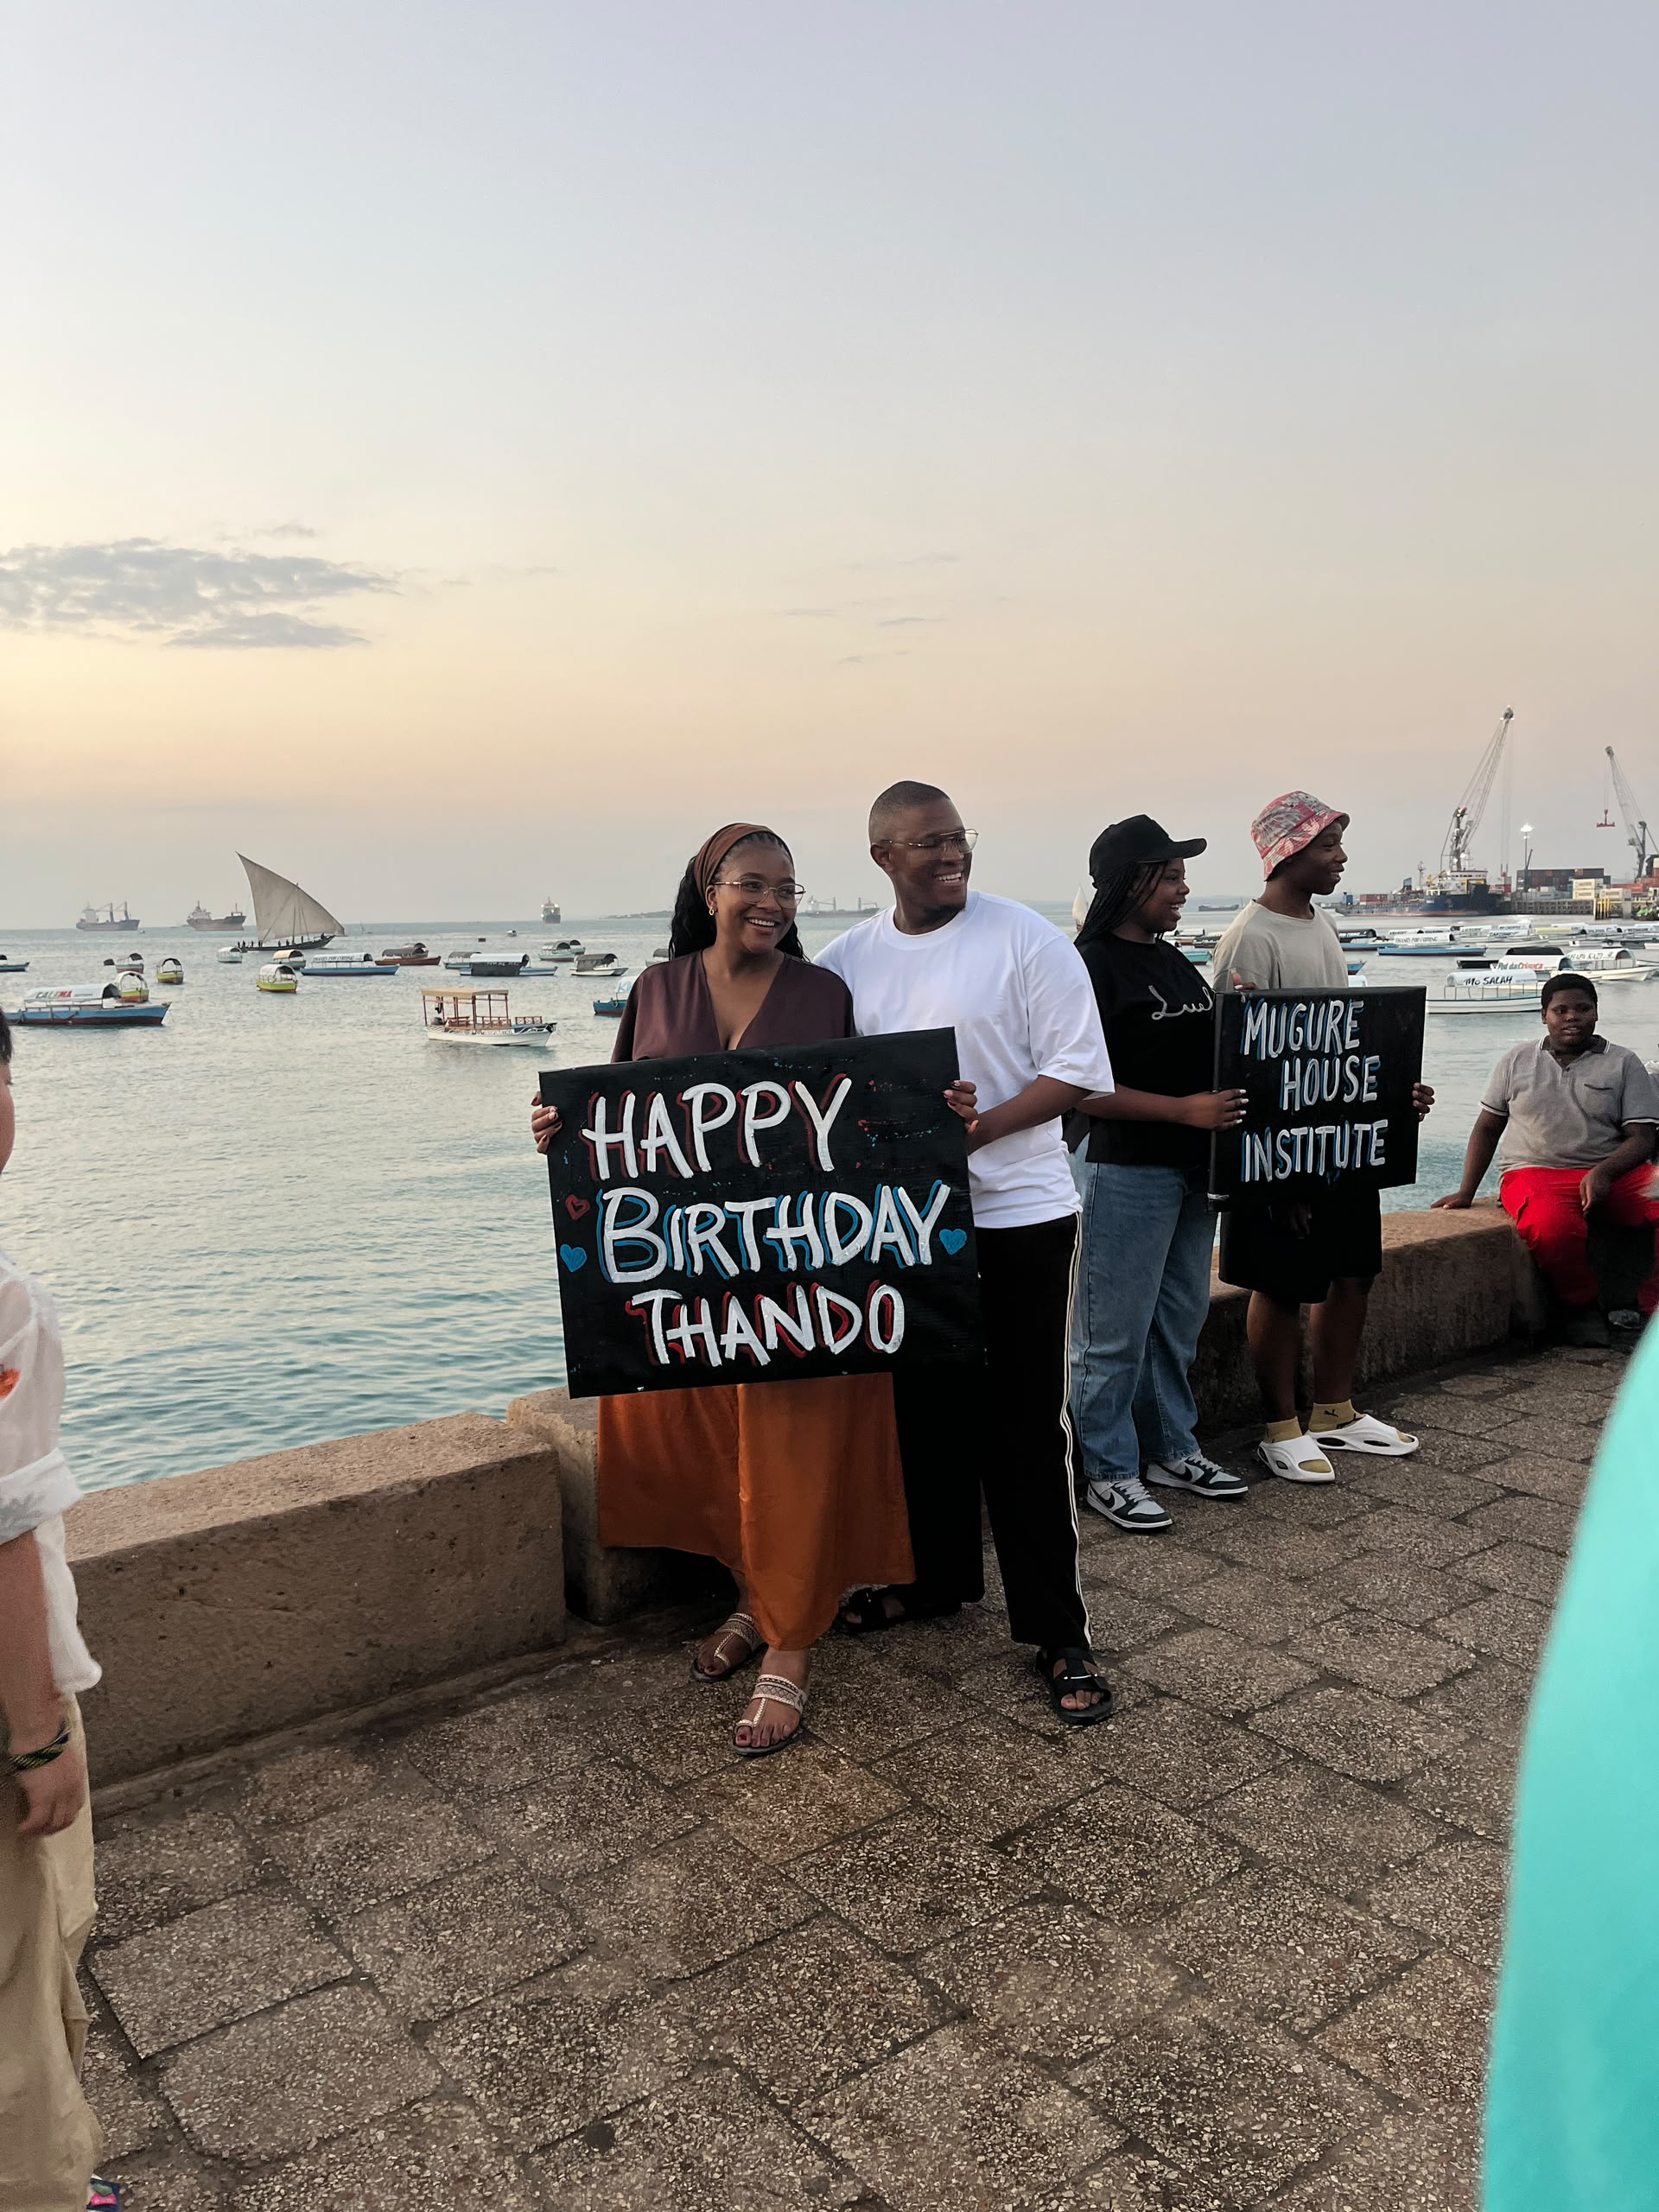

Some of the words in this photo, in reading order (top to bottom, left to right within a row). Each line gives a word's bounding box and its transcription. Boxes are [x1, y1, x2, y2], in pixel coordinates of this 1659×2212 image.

[1483, 976, 1513, 985] SALAH
[1241, 999, 1363, 1060] MUGURE
[1281, 1055, 1381, 1110] HOUSE
[579, 1074, 851, 1180] HAPPY
[1242, 1120, 1388, 1182] INSTITUTE
[596, 1180, 950, 1282] BIRTHDAY
[626, 1281, 905, 1366] THANDO
